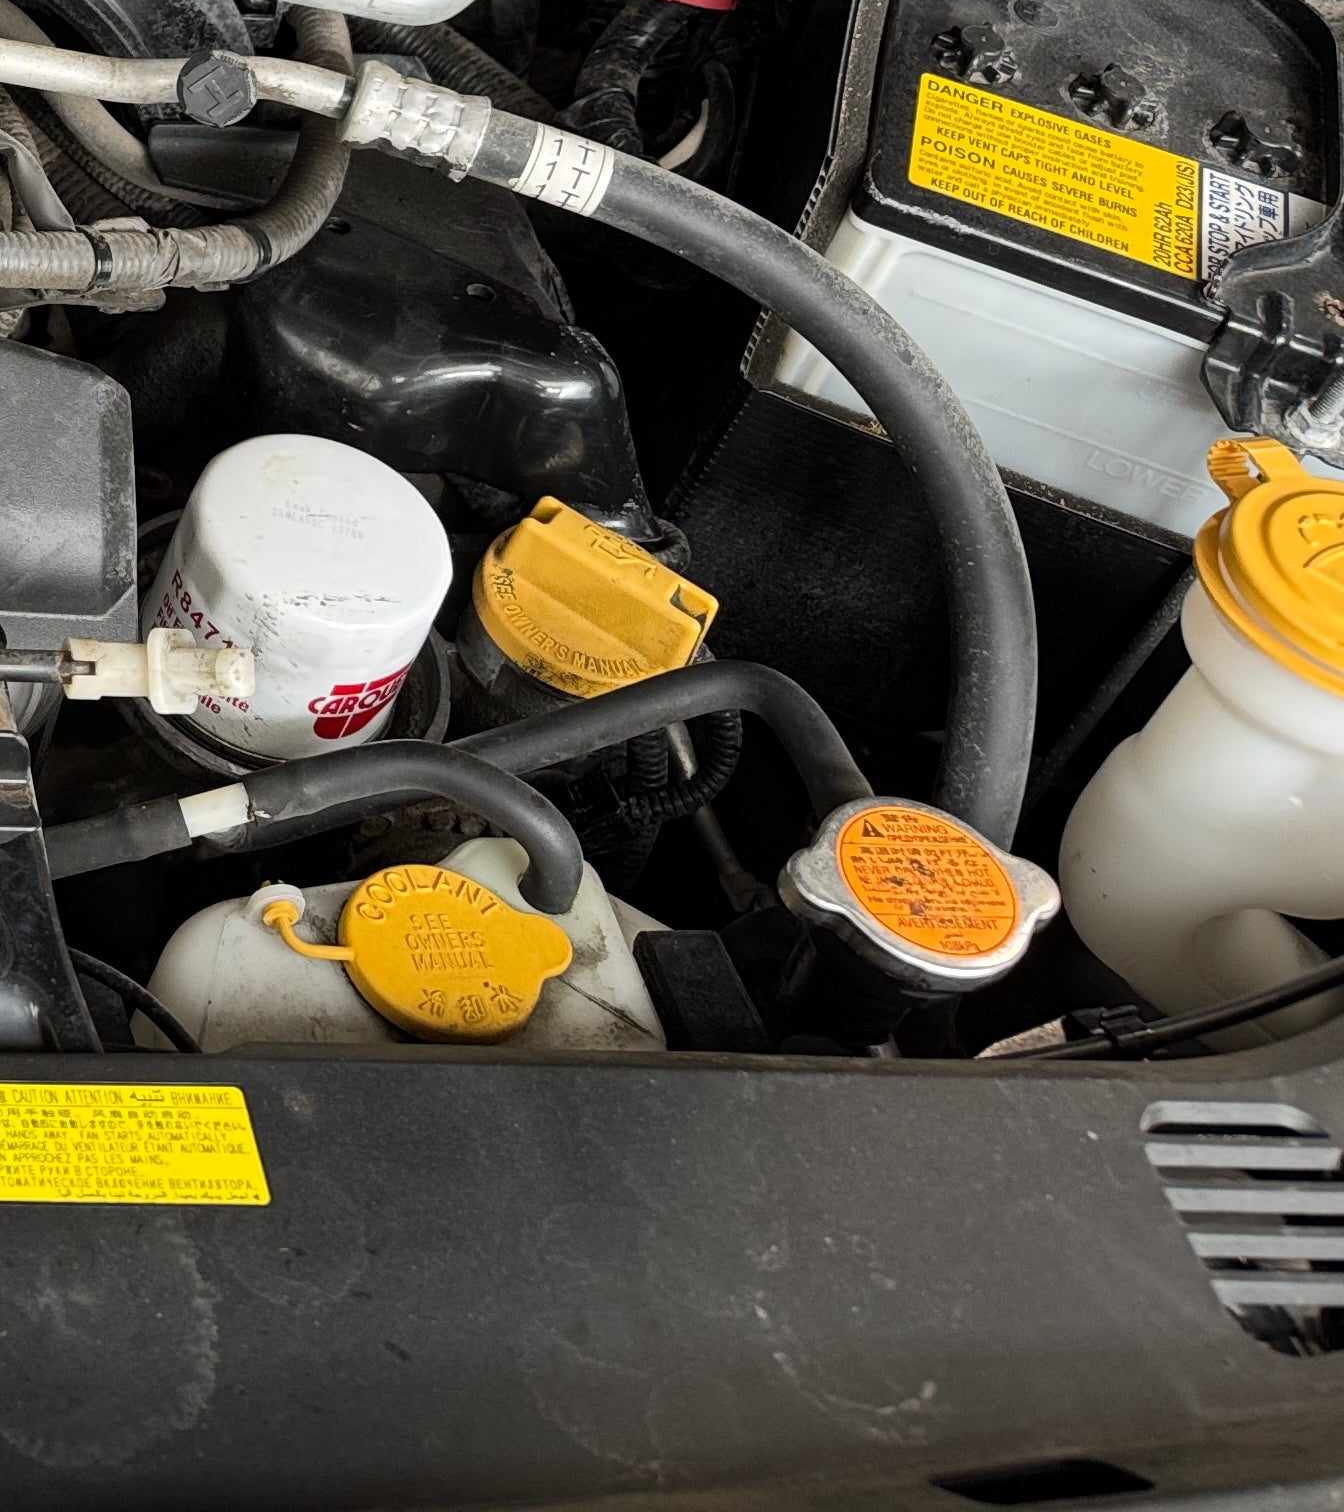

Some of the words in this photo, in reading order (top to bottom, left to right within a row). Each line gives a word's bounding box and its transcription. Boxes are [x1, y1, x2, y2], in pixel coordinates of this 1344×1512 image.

[927, 79, 1003, 113] DANGER
[1010, 107, 1069, 135] EXPLOSIVE
[1074, 128, 1111, 149] GASES
[920, 135, 996, 170] POISON
[1002, 163, 1047, 187] CAUSES
[1051, 179, 1094, 203] SEVERE
[1098, 195, 1137, 218] BURNS
[936, 125, 965, 143] KEEP
[967, 135, 997, 154] VENT
[1000, 146, 1030, 165] CAPS
[1034, 157, 1068, 177] TIGHT
[1071, 170, 1095, 187] AND
[1099, 179, 1134, 200] LEVEL
[1209, 172, 1231, 213] START
[930, 176, 959, 195] KEEP
[962, 187, 986, 204] OUT
[989, 196, 1004, 210] OF
[1007, 202, 1047, 225] REACH
[1050, 216, 1066, 231] OF
[1069, 223, 1129, 253] CHILDREN
[1154, 201, 1173, 229] 62Ah
[1174, 215, 1194, 245] 620A
[1208, 221, 1230, 261] STOP
[1153, 230, 1173, 268] 20HR
[1173, 244, 1194, 274] CCA
[572, 649, 649, 679] MANUAL
[882, 823, 949, 834] WARNING
[355, 868, 501, 923] COOLANT
[409, 913, 454, 932] SEE
[404, 931, 486, 950] OWNERS
[411, 950, 495, 972] MANUAL
[10, 1088, 59, 1103] CAUTION
[62, 1089, 124, 1104] ATTENTION
[78, 1130, 99, 1140] FAN
[102, 1130, 141, 1141] STARTS
[76, 1153, 98, 1163] PAS
[103, 1154, 125, 1164] LES
